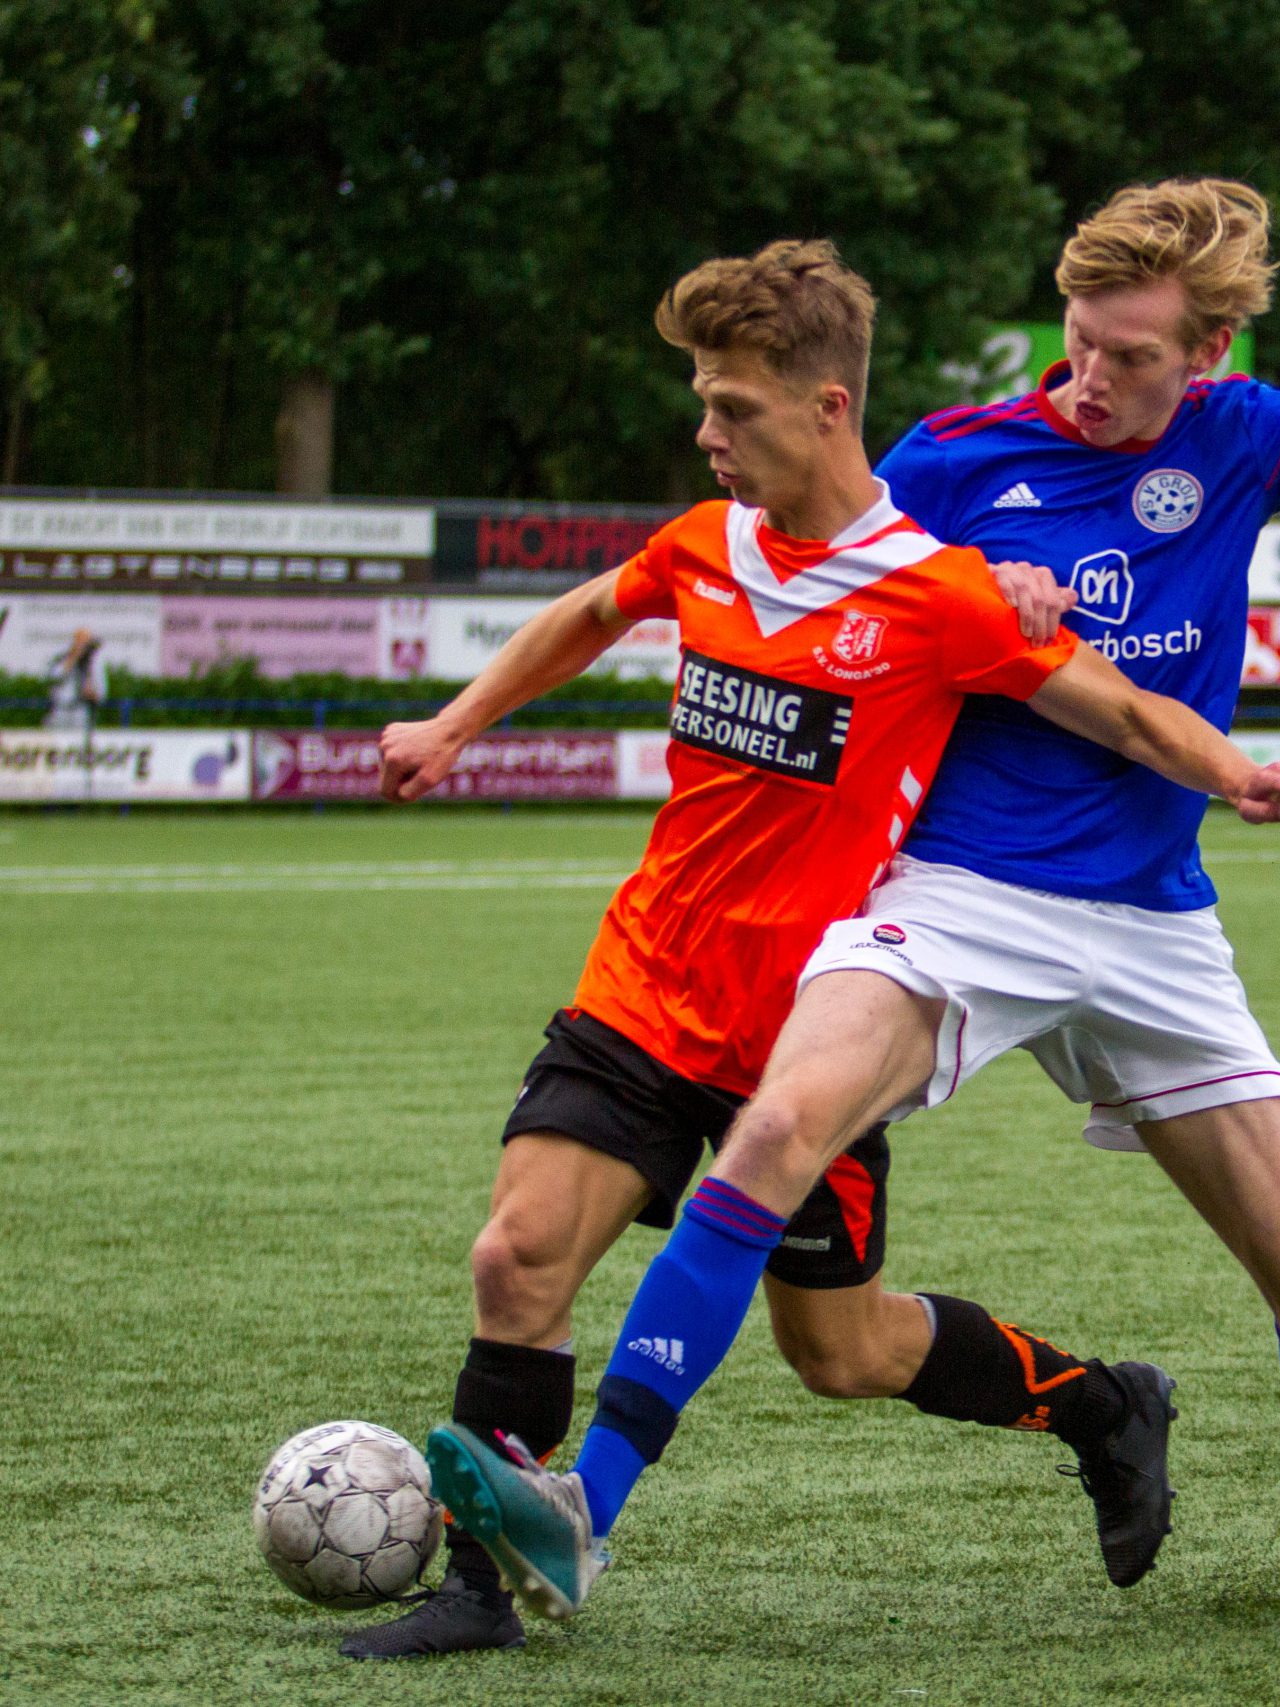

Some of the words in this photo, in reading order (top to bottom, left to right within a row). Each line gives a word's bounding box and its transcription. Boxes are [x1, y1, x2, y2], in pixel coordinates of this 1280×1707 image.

[680, 661, 802, 732] SEESING
[671, 703, 817, 770] PERSONEEL.nl
[627, 1340, 685, 1376] adidas
